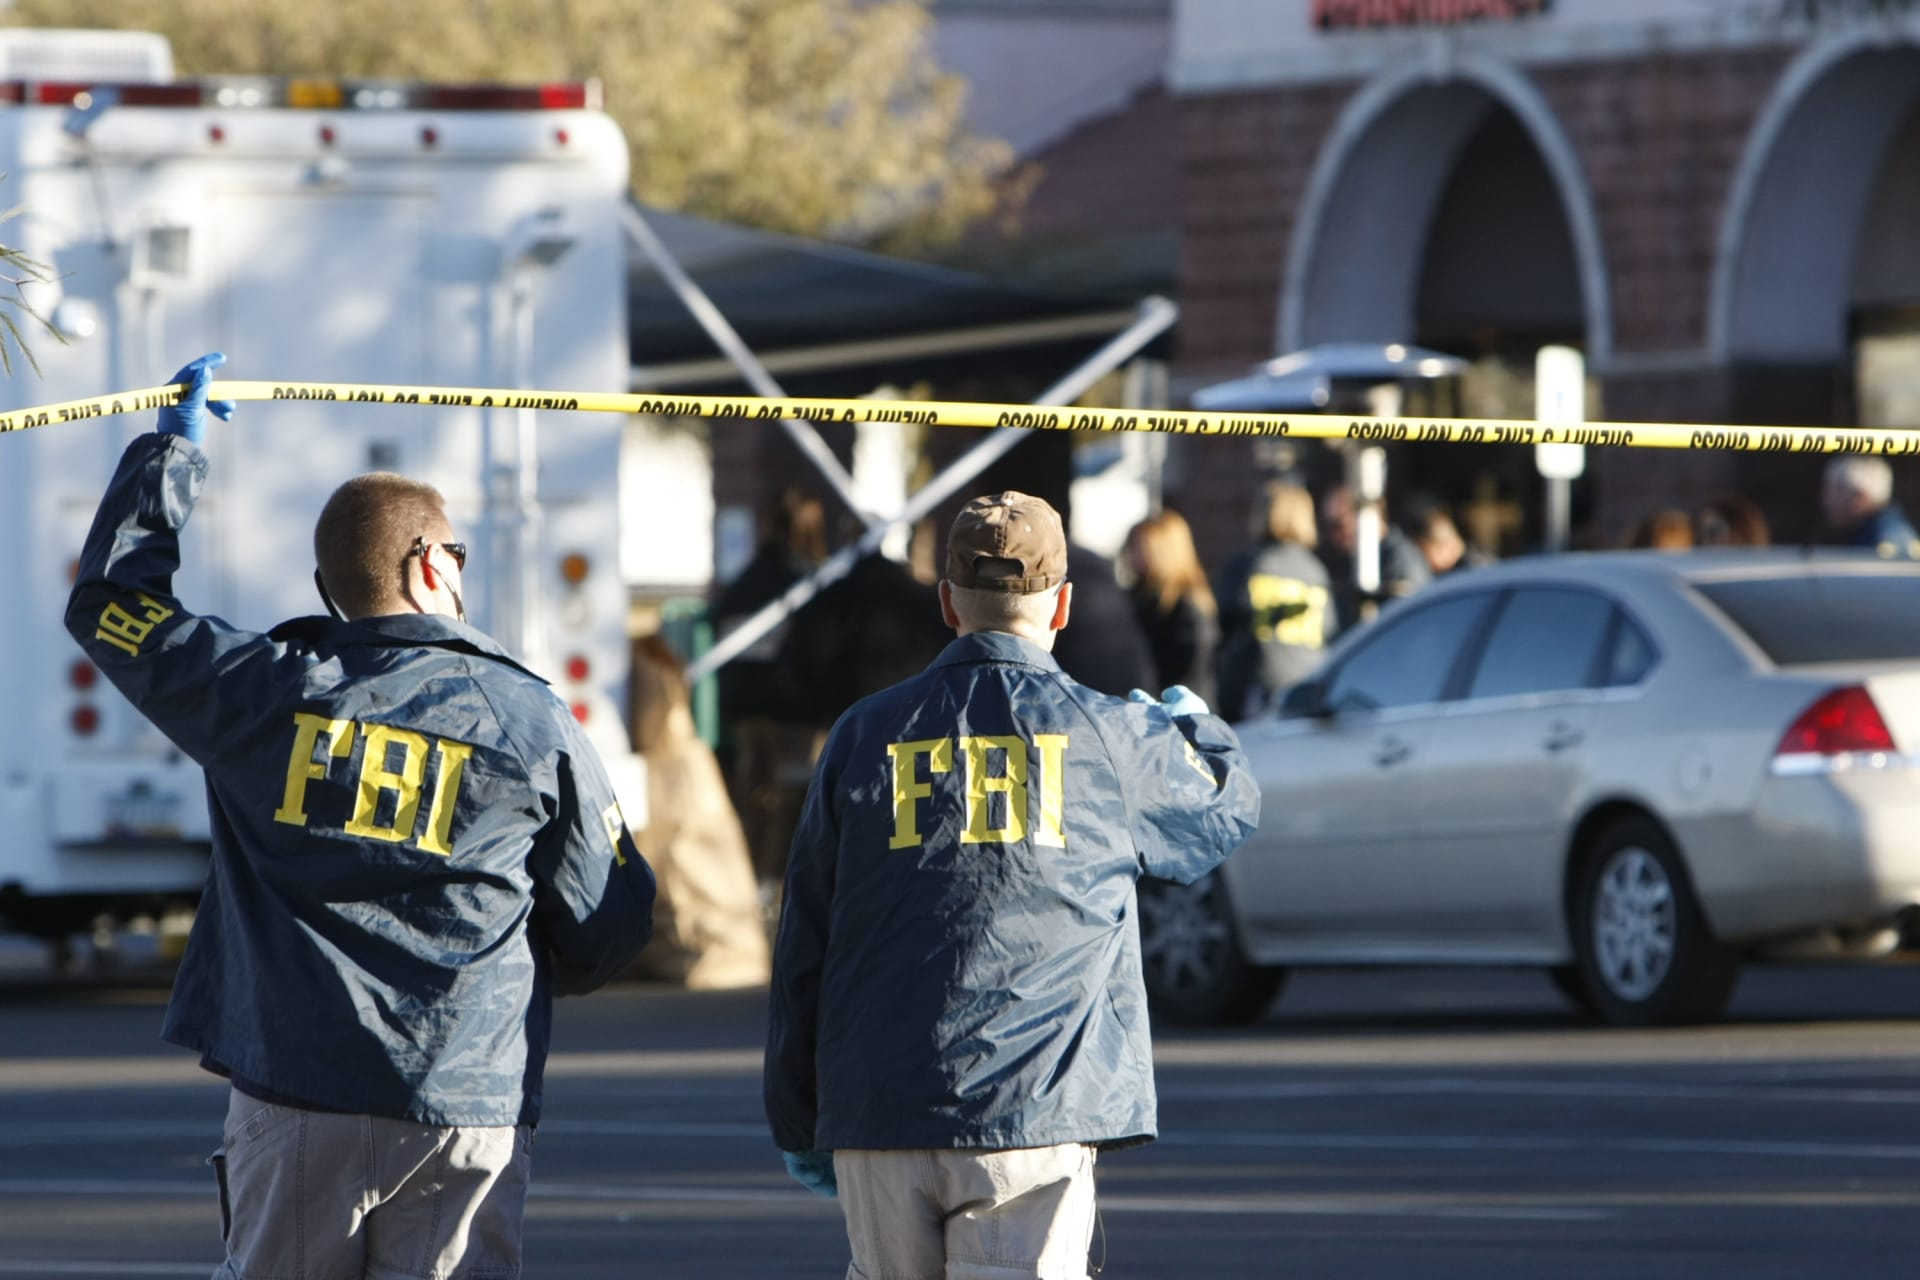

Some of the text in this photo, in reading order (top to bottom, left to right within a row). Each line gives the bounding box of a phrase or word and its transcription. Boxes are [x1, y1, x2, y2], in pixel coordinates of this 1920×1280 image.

[95, 592, 174, 657] FBI
[273, 712, 472, 857] FBI
[887, 733, 1069, 850] FBI
